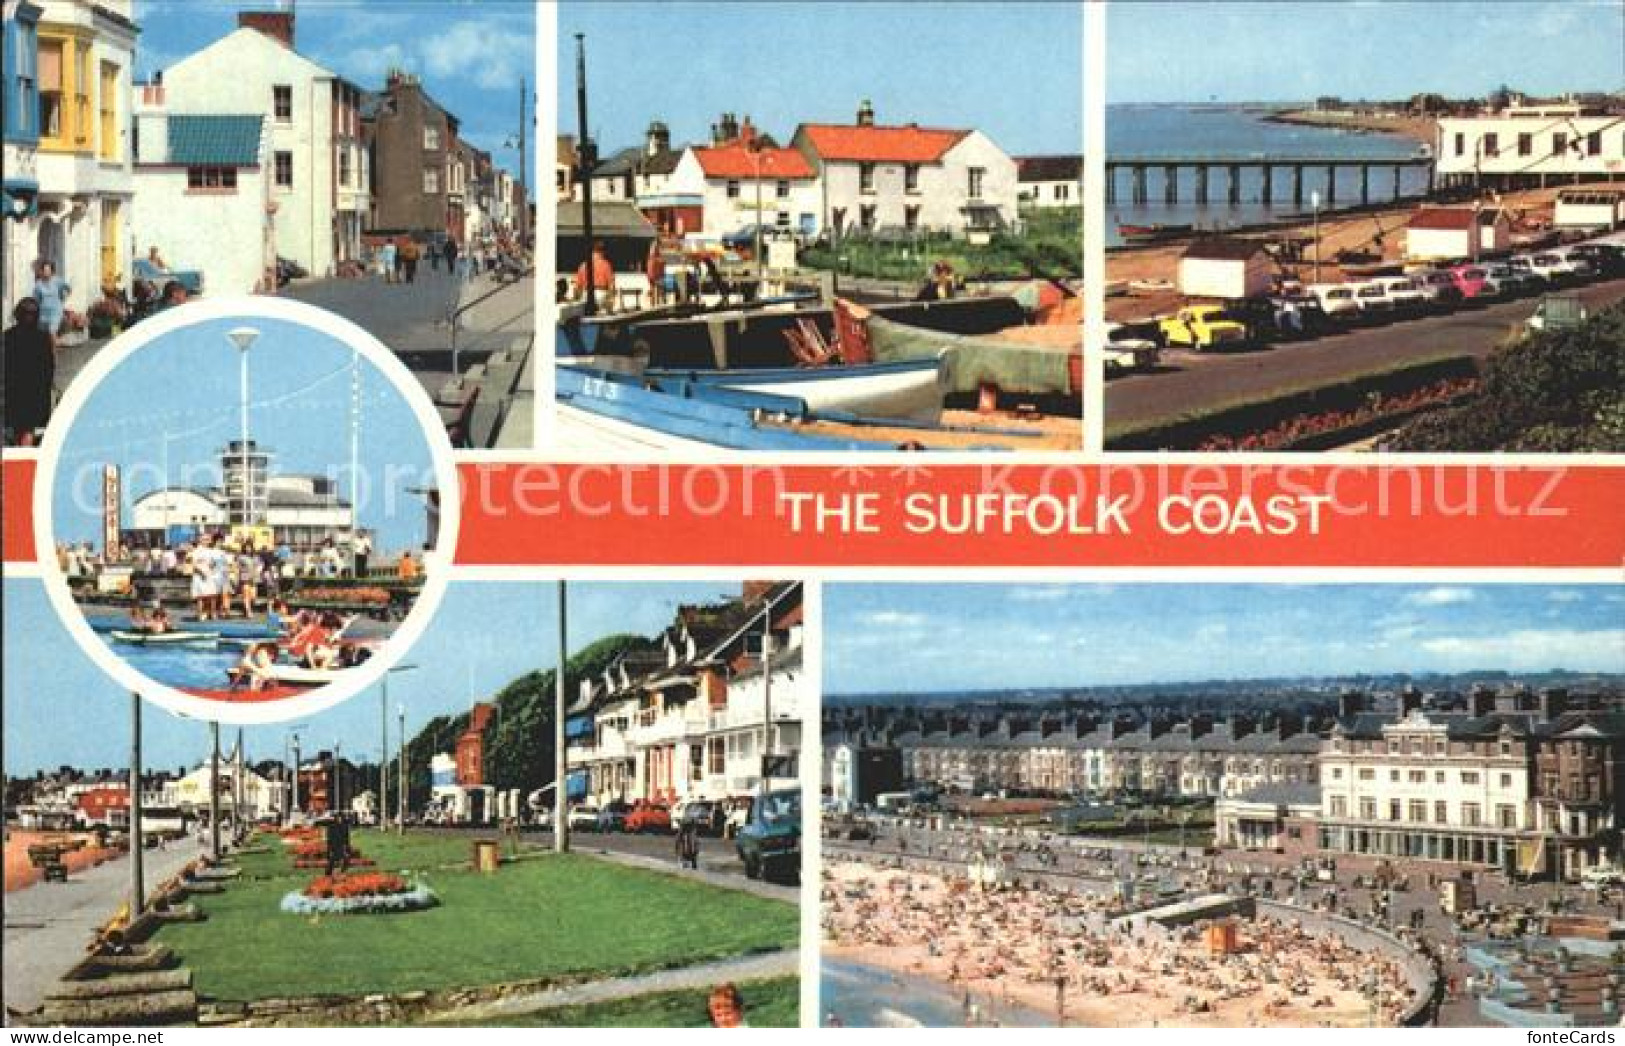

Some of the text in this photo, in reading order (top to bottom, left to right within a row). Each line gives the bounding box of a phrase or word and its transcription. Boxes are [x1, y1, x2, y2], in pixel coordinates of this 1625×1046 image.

[779, 491, 1332, 533] THE SUFFOLK COAST
